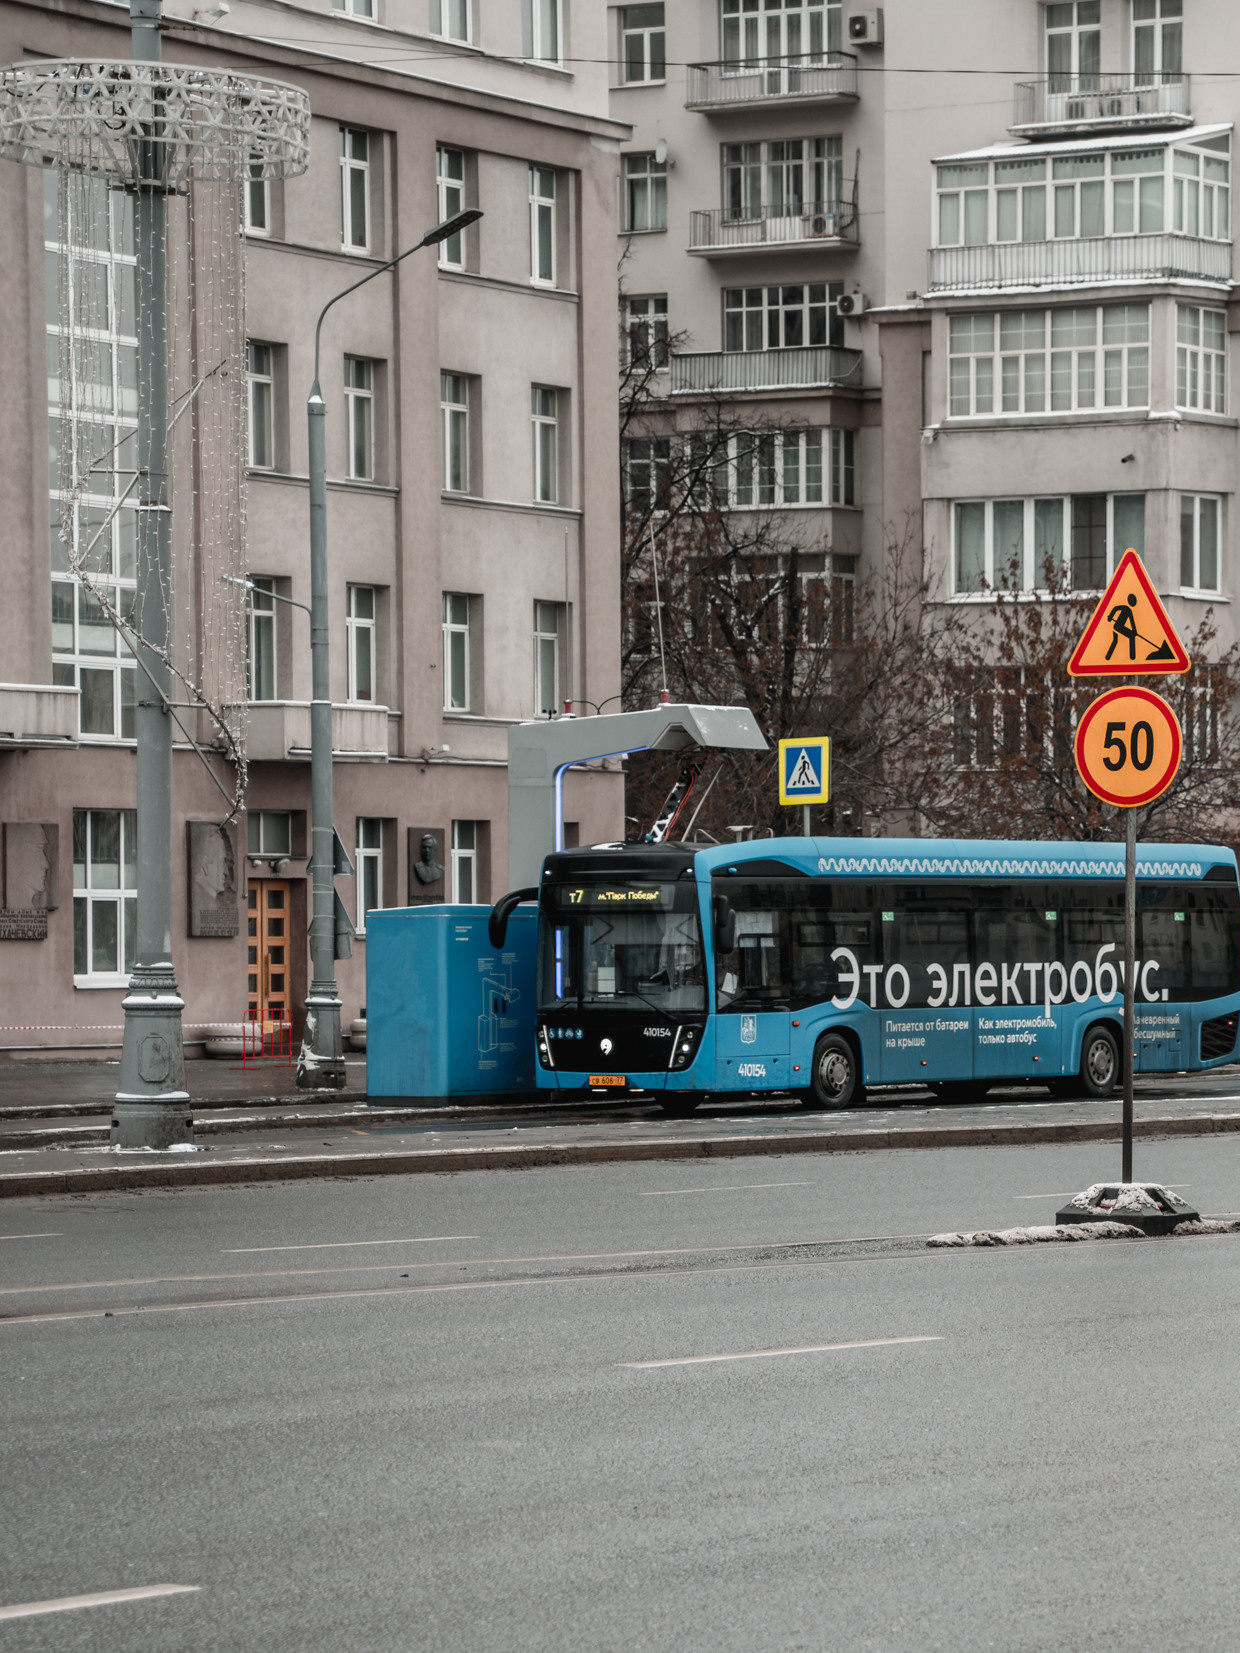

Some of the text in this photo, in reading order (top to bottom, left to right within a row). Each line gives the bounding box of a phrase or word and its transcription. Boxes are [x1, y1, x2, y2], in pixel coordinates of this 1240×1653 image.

[1103, 721, 1154, 771] 50
[830, 942, 1169, 1018] Это электробус.
[886, 1018, 969, 1032] Питается от батареи
[978, 1016, 1057, 1031] Как электромобиль,
[1133, 1013, 1180, 1027] аневренный
[643, 1027, 671, 1037] 410154
[978, 1031, 1037, 1046] только автобус
[886, 1037, 926, 1050] на крыше
[738, 1063, 767, 1077] 410154
[601, 1076, 614, 1085] 606
